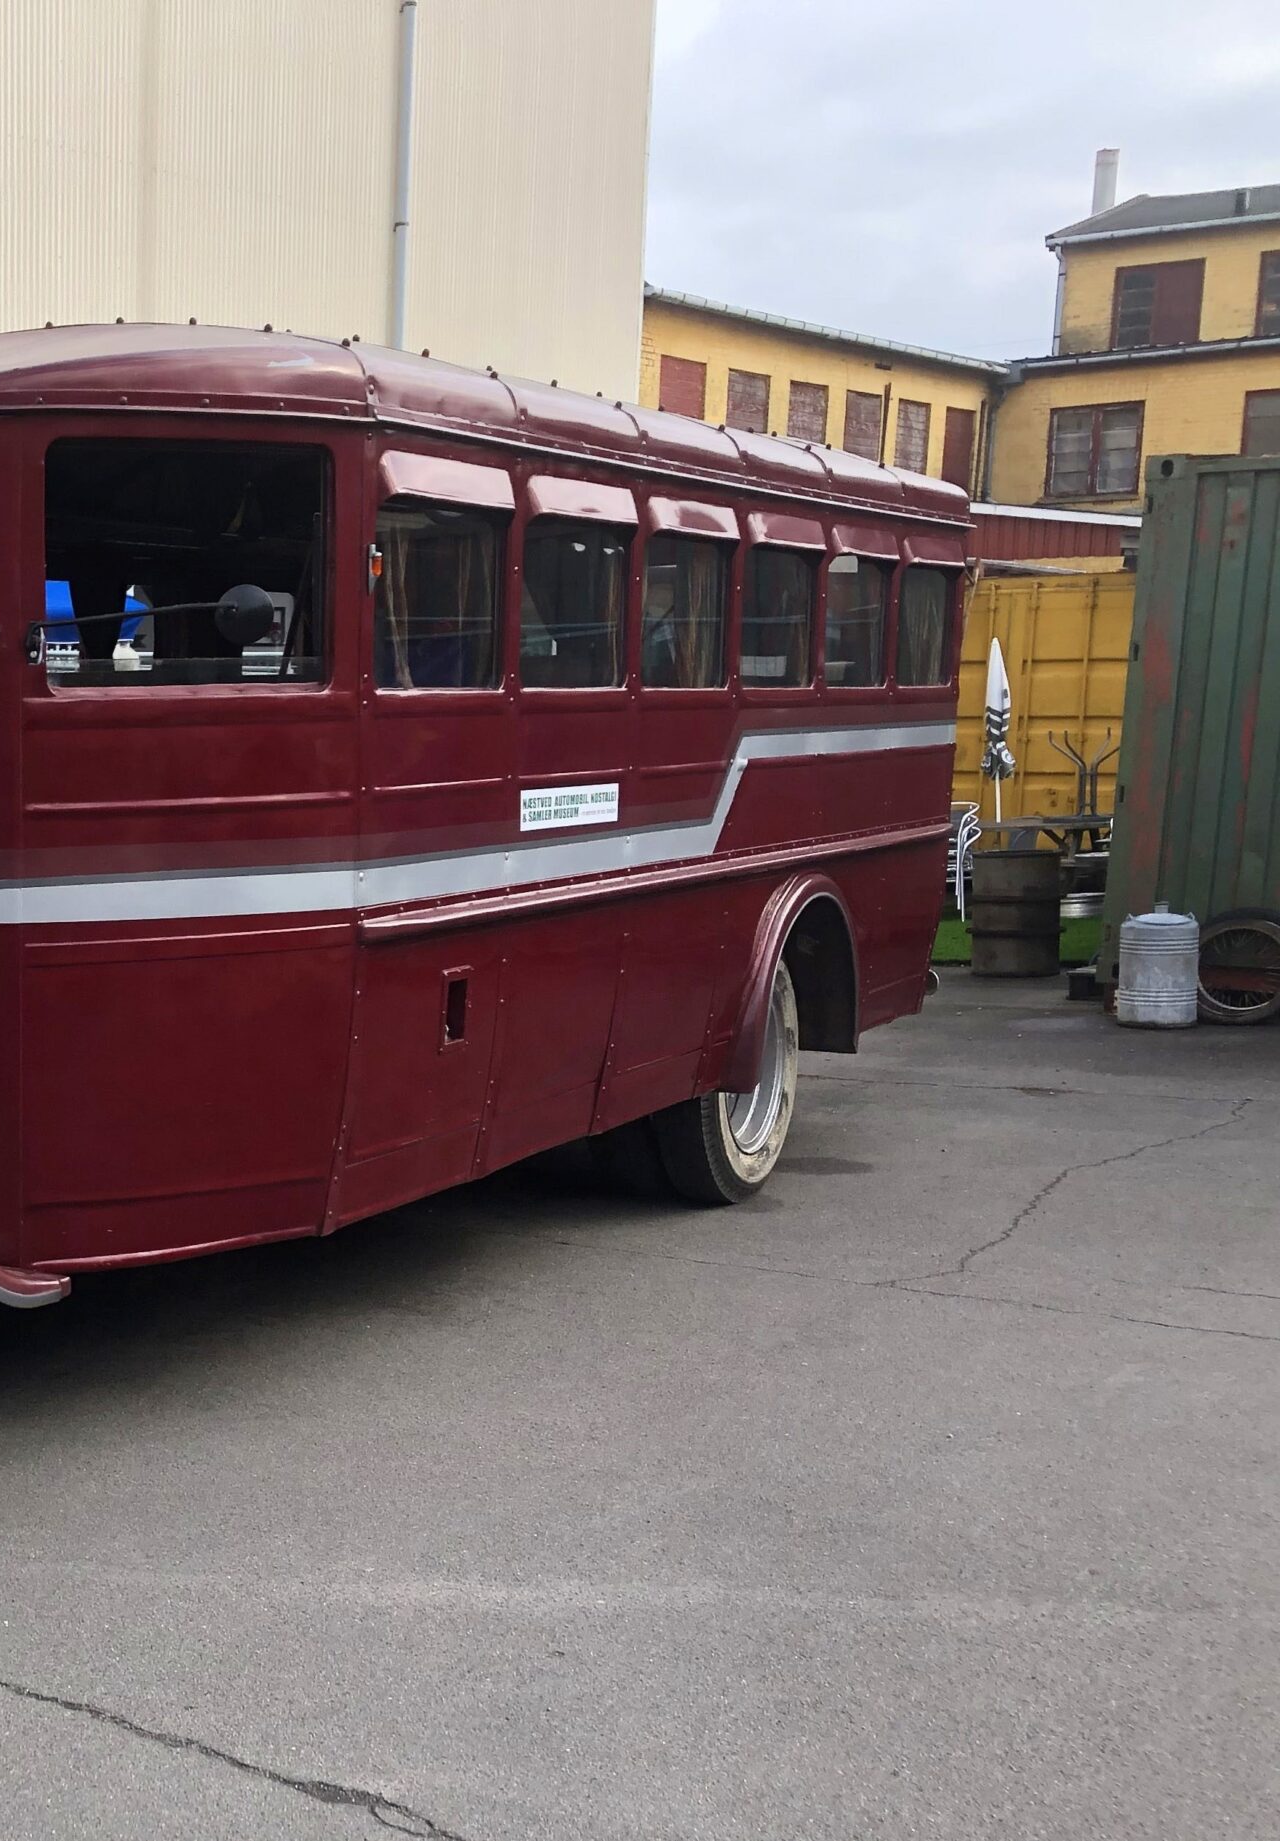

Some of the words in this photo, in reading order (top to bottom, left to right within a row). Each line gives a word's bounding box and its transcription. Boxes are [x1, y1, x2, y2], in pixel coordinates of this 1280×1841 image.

[523, 797, 551, 809] NÆSTVED
[591, 791, 616, 803] NOSTALGI
[523, 813, 527, 823] &
[529, 810, 552, 822] SAMLER
[553, 807, 579, 819] MUSEUM
